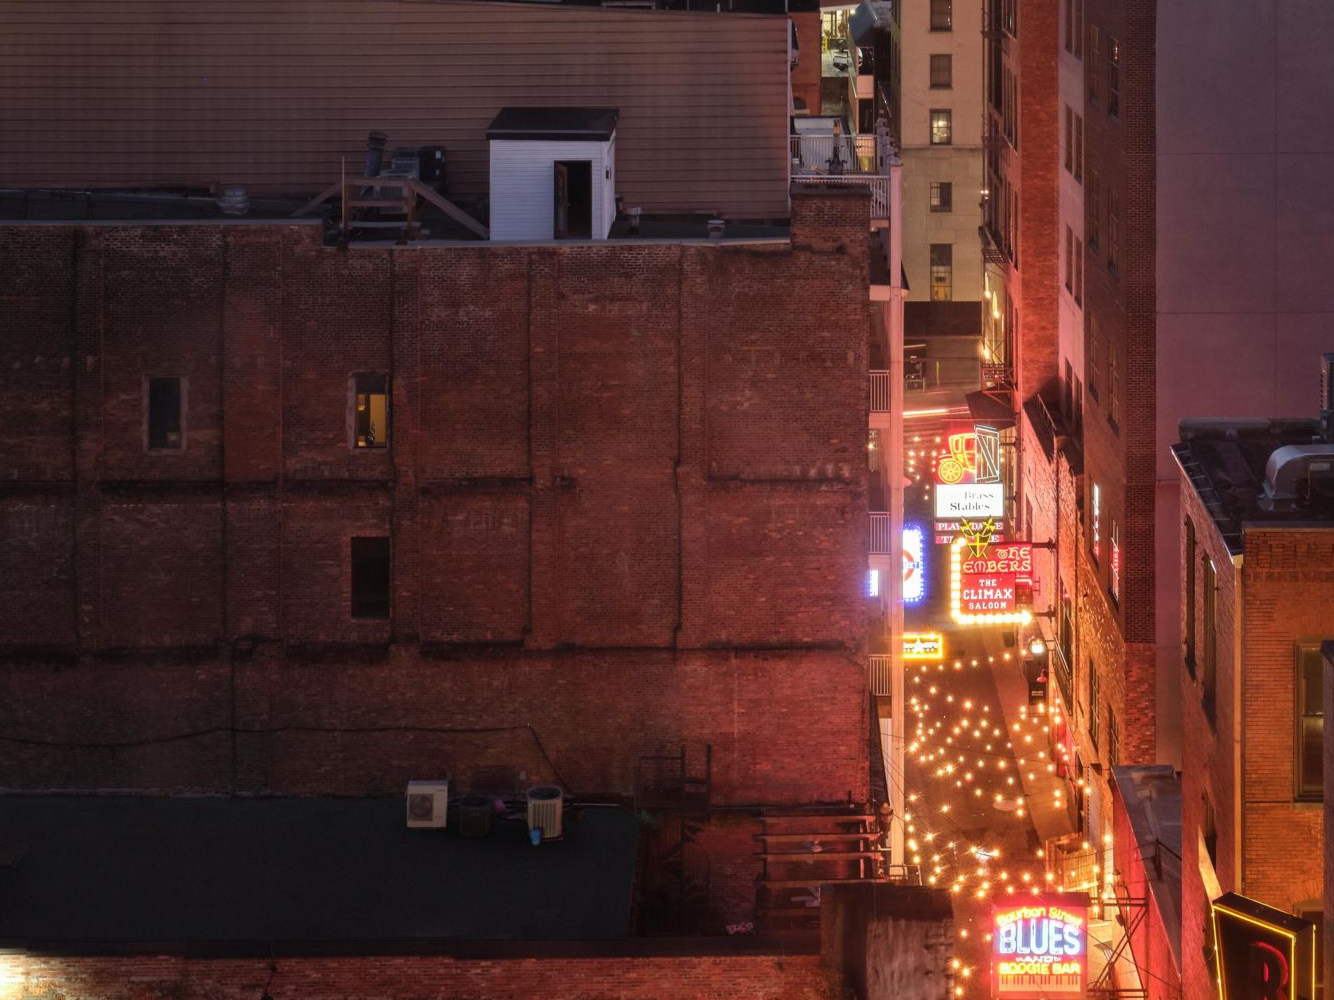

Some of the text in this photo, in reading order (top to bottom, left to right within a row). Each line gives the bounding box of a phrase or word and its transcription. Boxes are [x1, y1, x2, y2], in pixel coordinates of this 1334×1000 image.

[950, 501, 990, 511] Stables
[962, 559, 1032, 573] EMBERS
[963, 588, 1013, 600] CLIMAX
[968, 602, 1007, 610] SALOON
[996, 906, 1083, 926] Bourbon Street
[999, 918, 1081, 955] BLUES
[998, 961, 1081, 975] BOOGIE BAR
